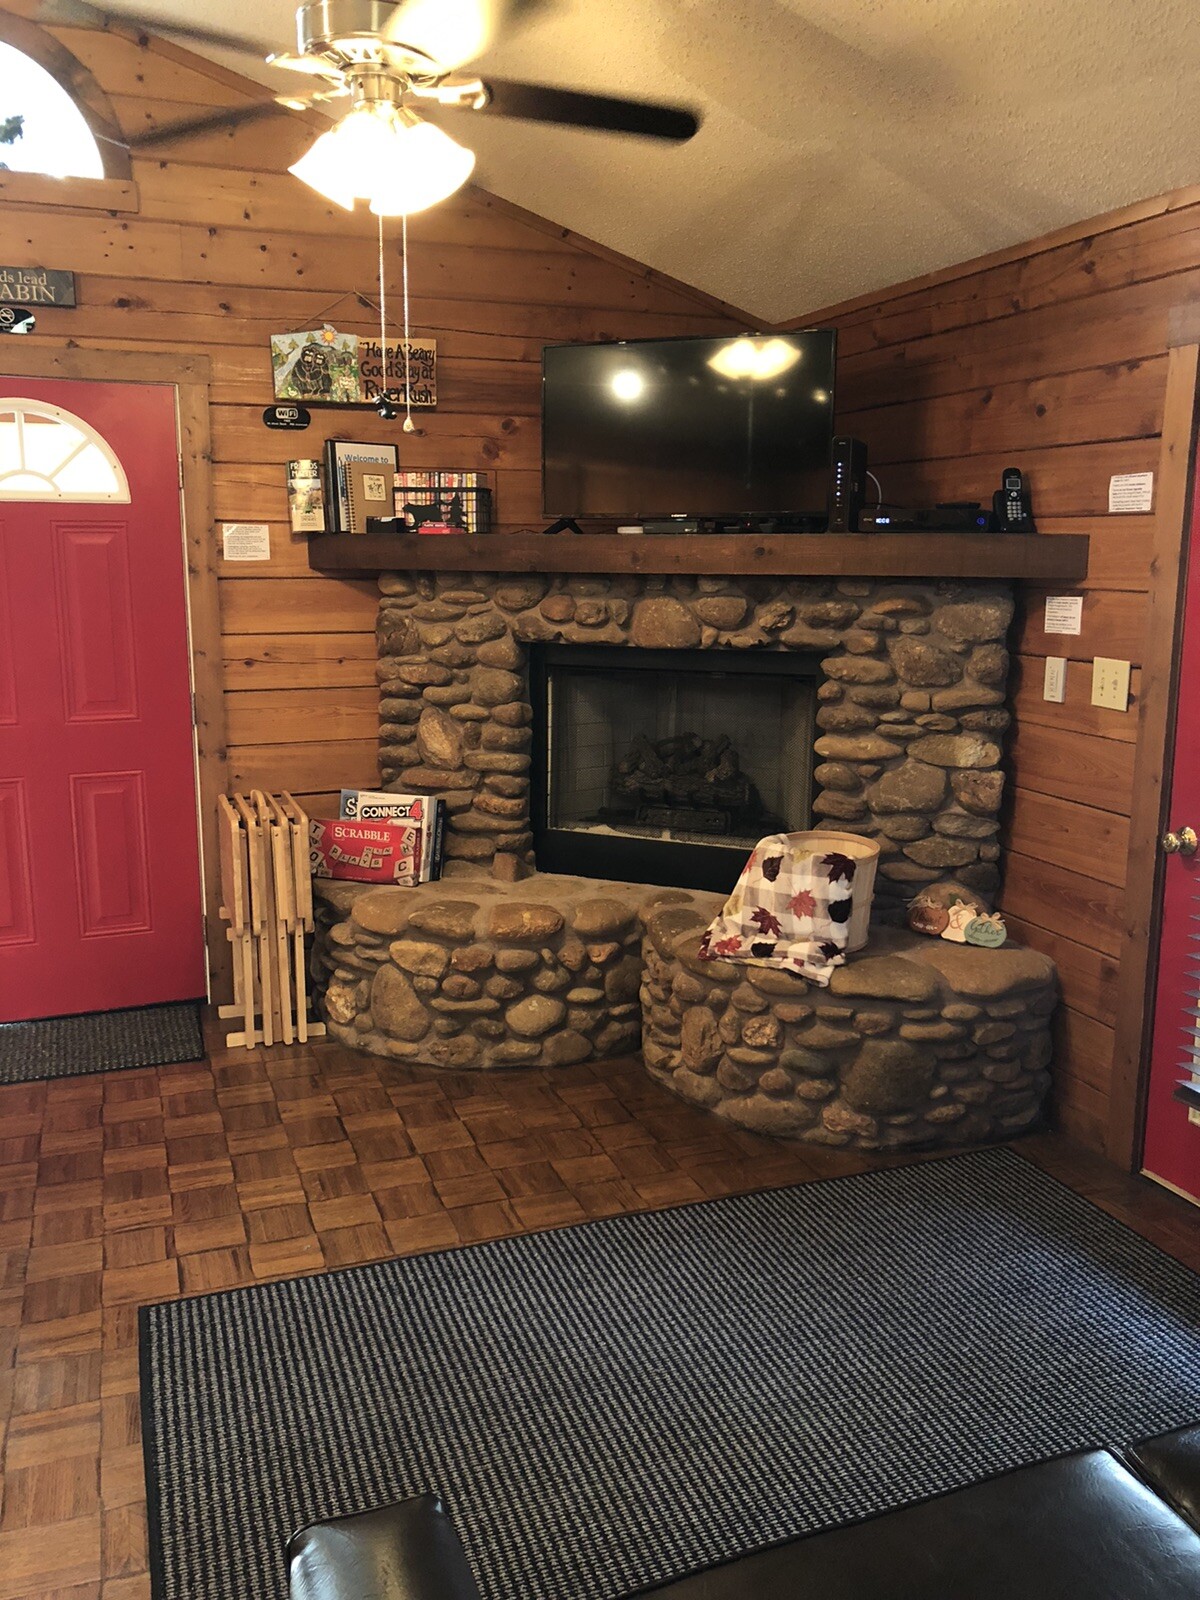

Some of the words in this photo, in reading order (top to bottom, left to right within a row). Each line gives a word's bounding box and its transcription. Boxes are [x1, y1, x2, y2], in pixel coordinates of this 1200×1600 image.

[18, 271, 47, 286] lead
[361, 361, 393, 377] Good
[421, 367, 434, 380] at
[344, 454, 379, 463] Welcome
[361, 806, 411, 818] CONNECT
[409, 799, 423, 820] 4
[333, 825, 391, 842] SCRABBLE
